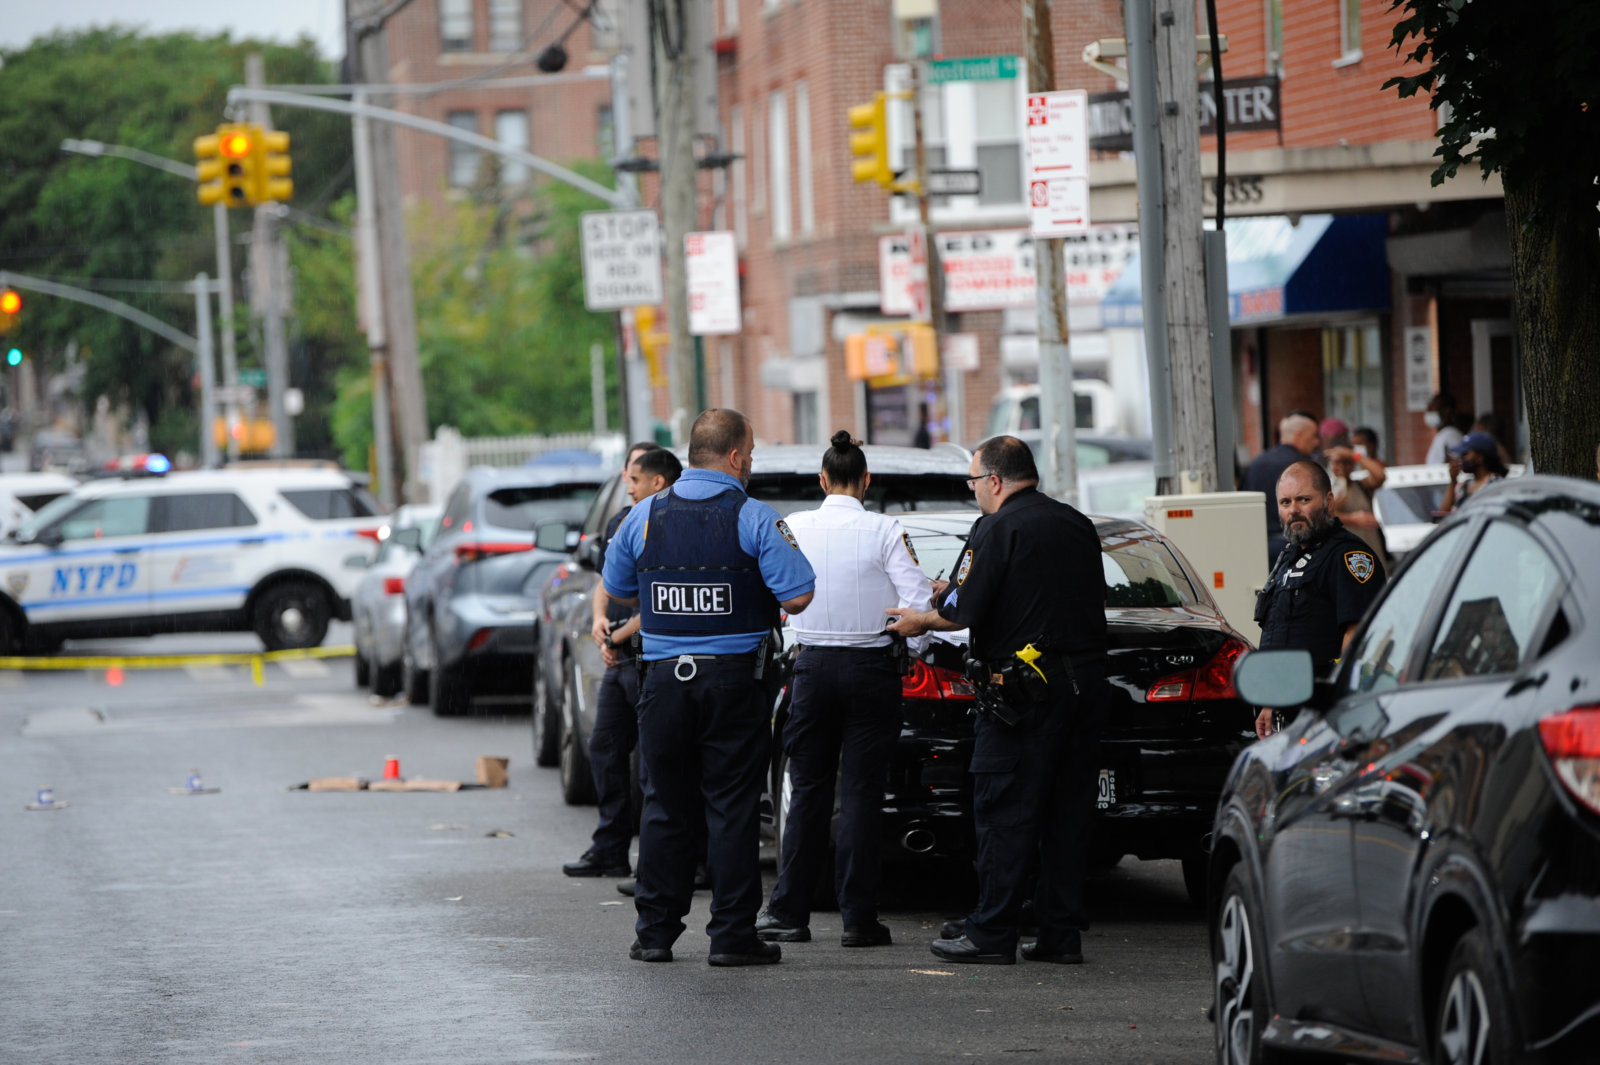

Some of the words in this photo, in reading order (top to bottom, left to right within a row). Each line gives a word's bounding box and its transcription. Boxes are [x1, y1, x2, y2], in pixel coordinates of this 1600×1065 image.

[588, 217, 652, 241] STOP
[52, 562, 137, 592] NYPD
[657, 586, 725, 612] POLICE
[1165, 655, 1194, 666] Q40
